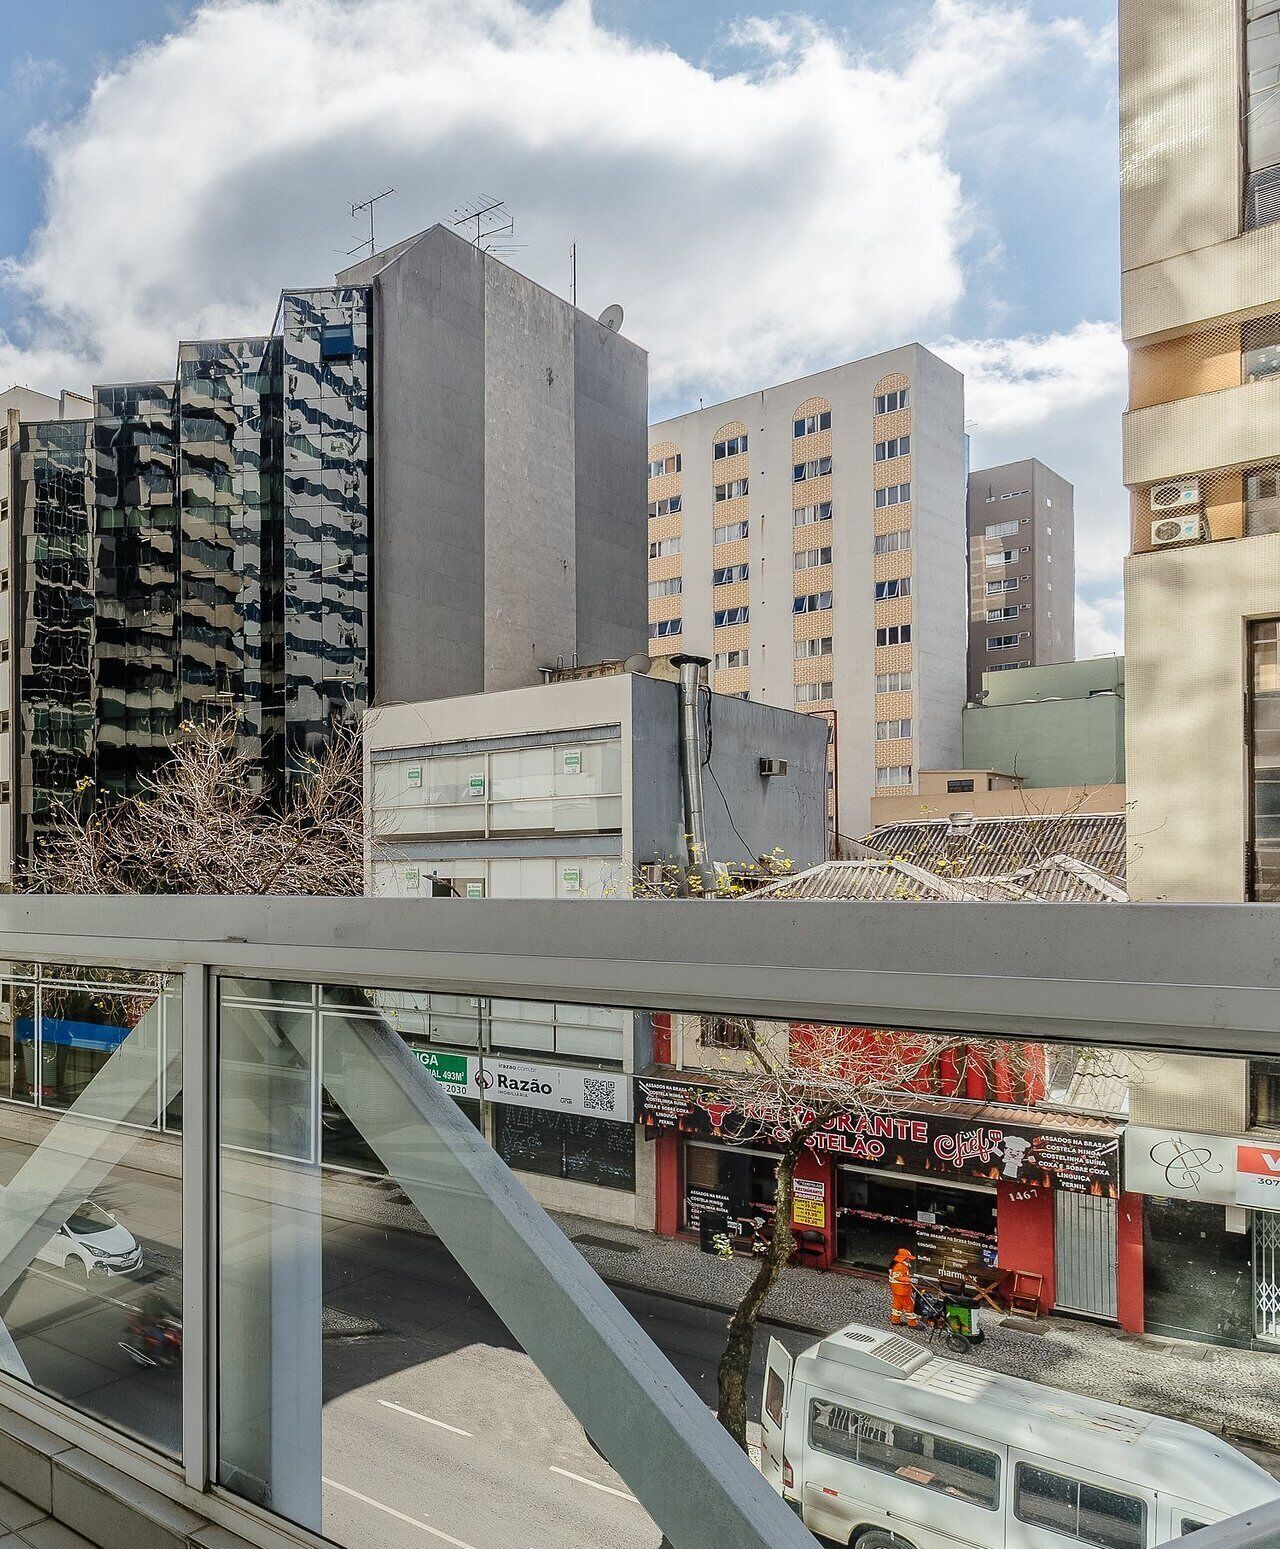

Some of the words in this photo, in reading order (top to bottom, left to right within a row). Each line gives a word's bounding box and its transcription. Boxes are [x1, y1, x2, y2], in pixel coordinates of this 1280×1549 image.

[497, 1073, 552, 1095] Razão
[772, 1127, 885, 1158] CSTELÃO
[933, 1127, 991, 1168] Chef
[1040, 1135, 1072, 1144] ASSADOS
[1083, 1140, 1107, 1149] BRASA
[1046, 1144, 1077, 1154] COSTELA
[1041, 1152, 1084, 1163] COSTELINHA
[1038, 1160, 1058, 1168] COXA
[1065, 1164, 1088, 1173] SOBRE
[1089, 1167, 1110, 1176] COXA
[1061, 1181, 1087, 1190] PERNIL
[1009, 1189, 1038, 1202] 1467
[938, 1269, 978, 1282] marmix
